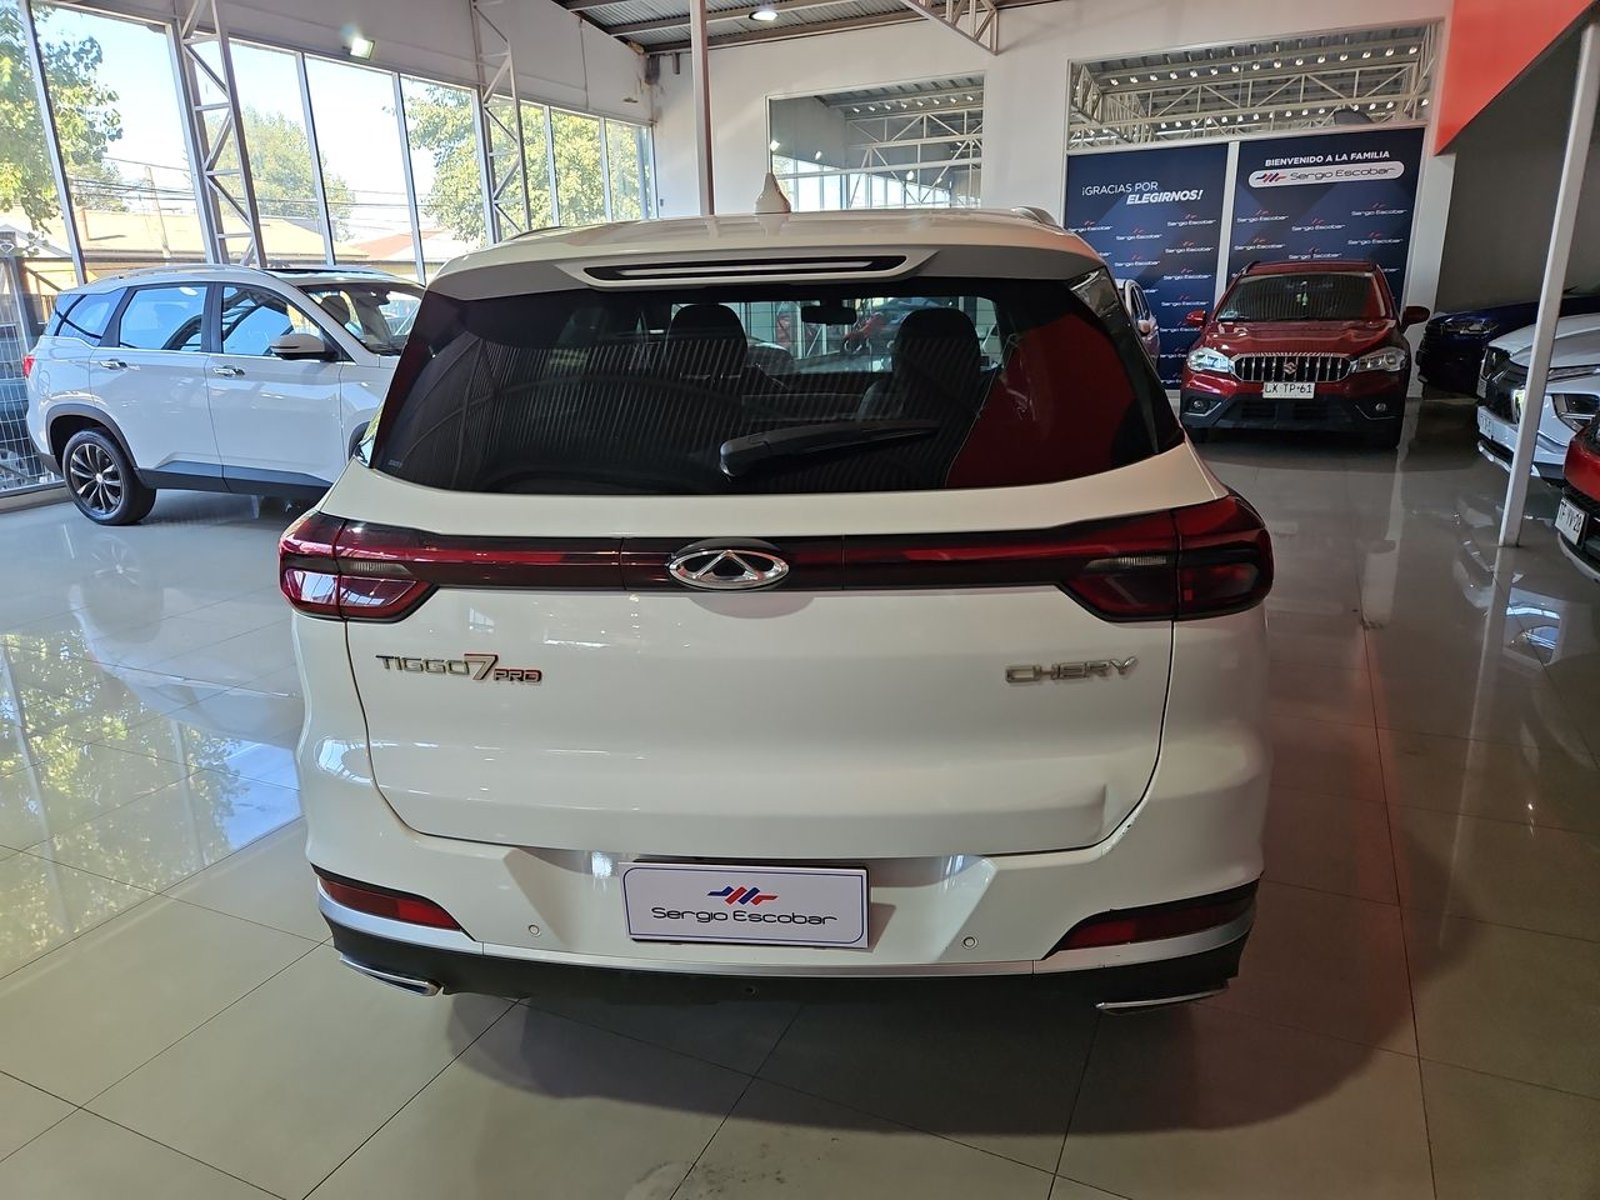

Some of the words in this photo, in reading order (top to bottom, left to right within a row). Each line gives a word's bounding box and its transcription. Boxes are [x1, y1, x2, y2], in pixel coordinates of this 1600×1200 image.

[1265, 156, 1323, 167] BIENVENIDO
[1335, 154, 1348, 162] LA
[1350, 151, 1390, 161] FAMILIA
[1335, 166, 1396, 177] Escobar
[1081, 183, 1132, 196] ¡GRACIAS
[1134, 181, 1159, 192] POR
[1126, 189, 1204, 205] ELEGIRNOS!
[493, 668, 543, 684] PRO
[1006, 656, 1137, 683] CHERY
[651, 906, 728, 924] Sergio
[732, 909, 838, 926] Escobar
